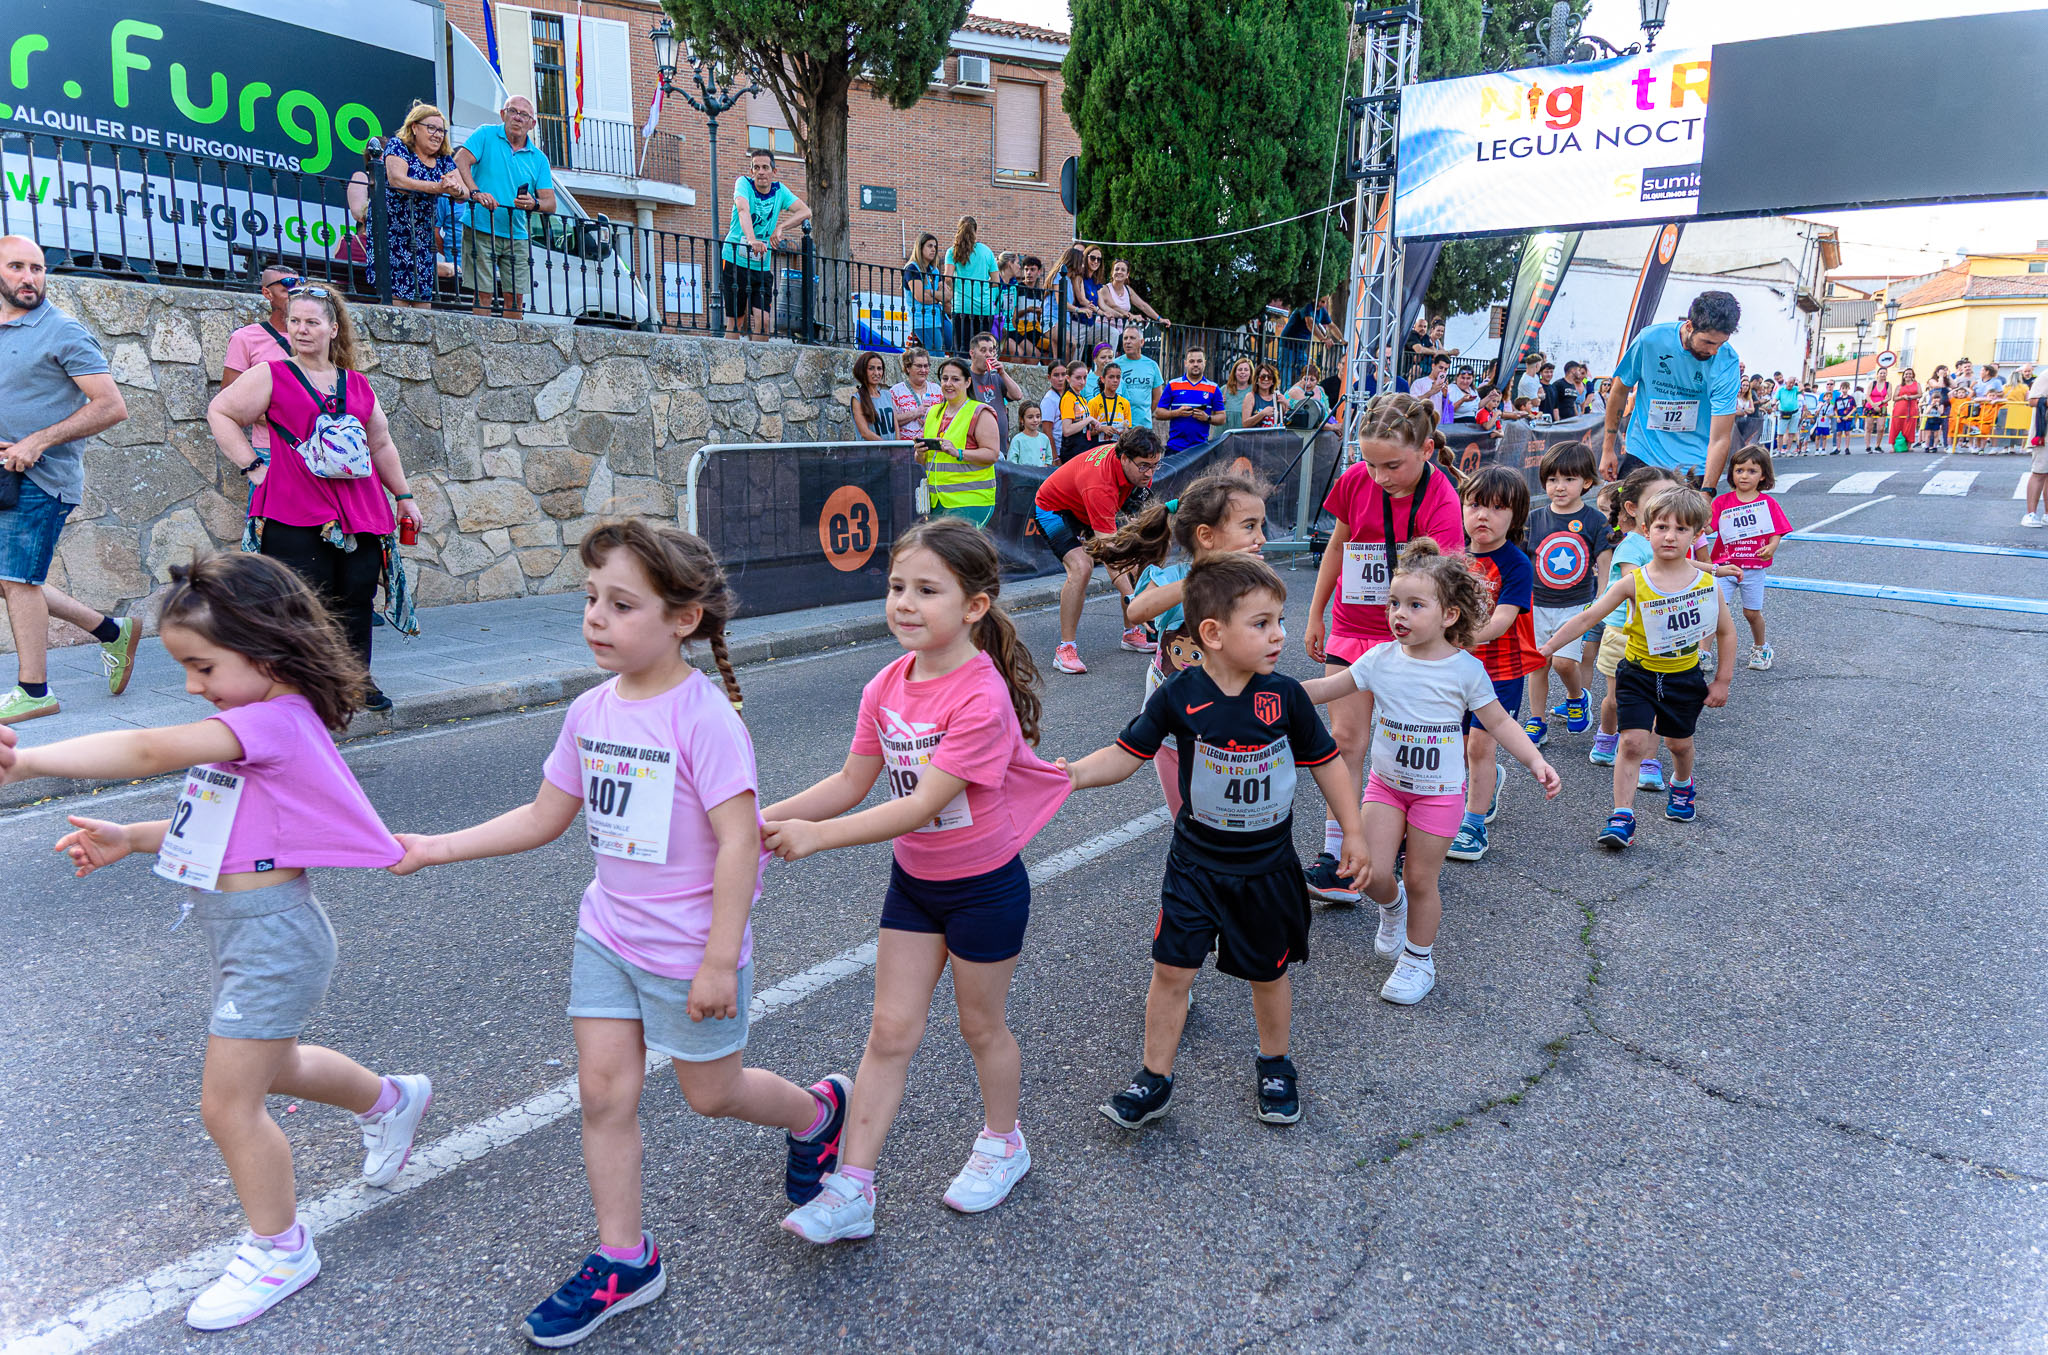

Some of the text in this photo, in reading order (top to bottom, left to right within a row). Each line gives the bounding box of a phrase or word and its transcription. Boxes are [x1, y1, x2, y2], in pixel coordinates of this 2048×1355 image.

[111, 19, 383, 173] Furgo
[14, 105, 301, 172] ALQUILER DE FURGONETAS
[1476, 117, 1701, 162] LEGUA NOCT
[1664, 411, 1682, 422] 172
[829, 502, 871, 555] e3
[1733, 513, 1757, 528] 409
[1362, 563, 1389, 583] 46
[1649, 599, 1667, 608] LEGUA
[1667, 590, 1697, 604] NOCTURNA
[1696, 586, 1715, 597] UGENA
[1667, 607, 1701, 632] 405
[1385, 719, 1403, 730] LEGUA
[1403, 724, 1442, 734] NOCTURNA
[594, 742, 638, 760] NOCTURNA
[639, 747, 671, 764] UGENA
[1206, 749, 1229, 763] LEGUA
[1230, 751, 1271, 764] NOCTURNA
[1395, 744, 1441, 771] 400
[207, 770, 239, 791] UGENA
[1224, 774, 1271, 805] 401
[589, 776, 633, 818] 407
